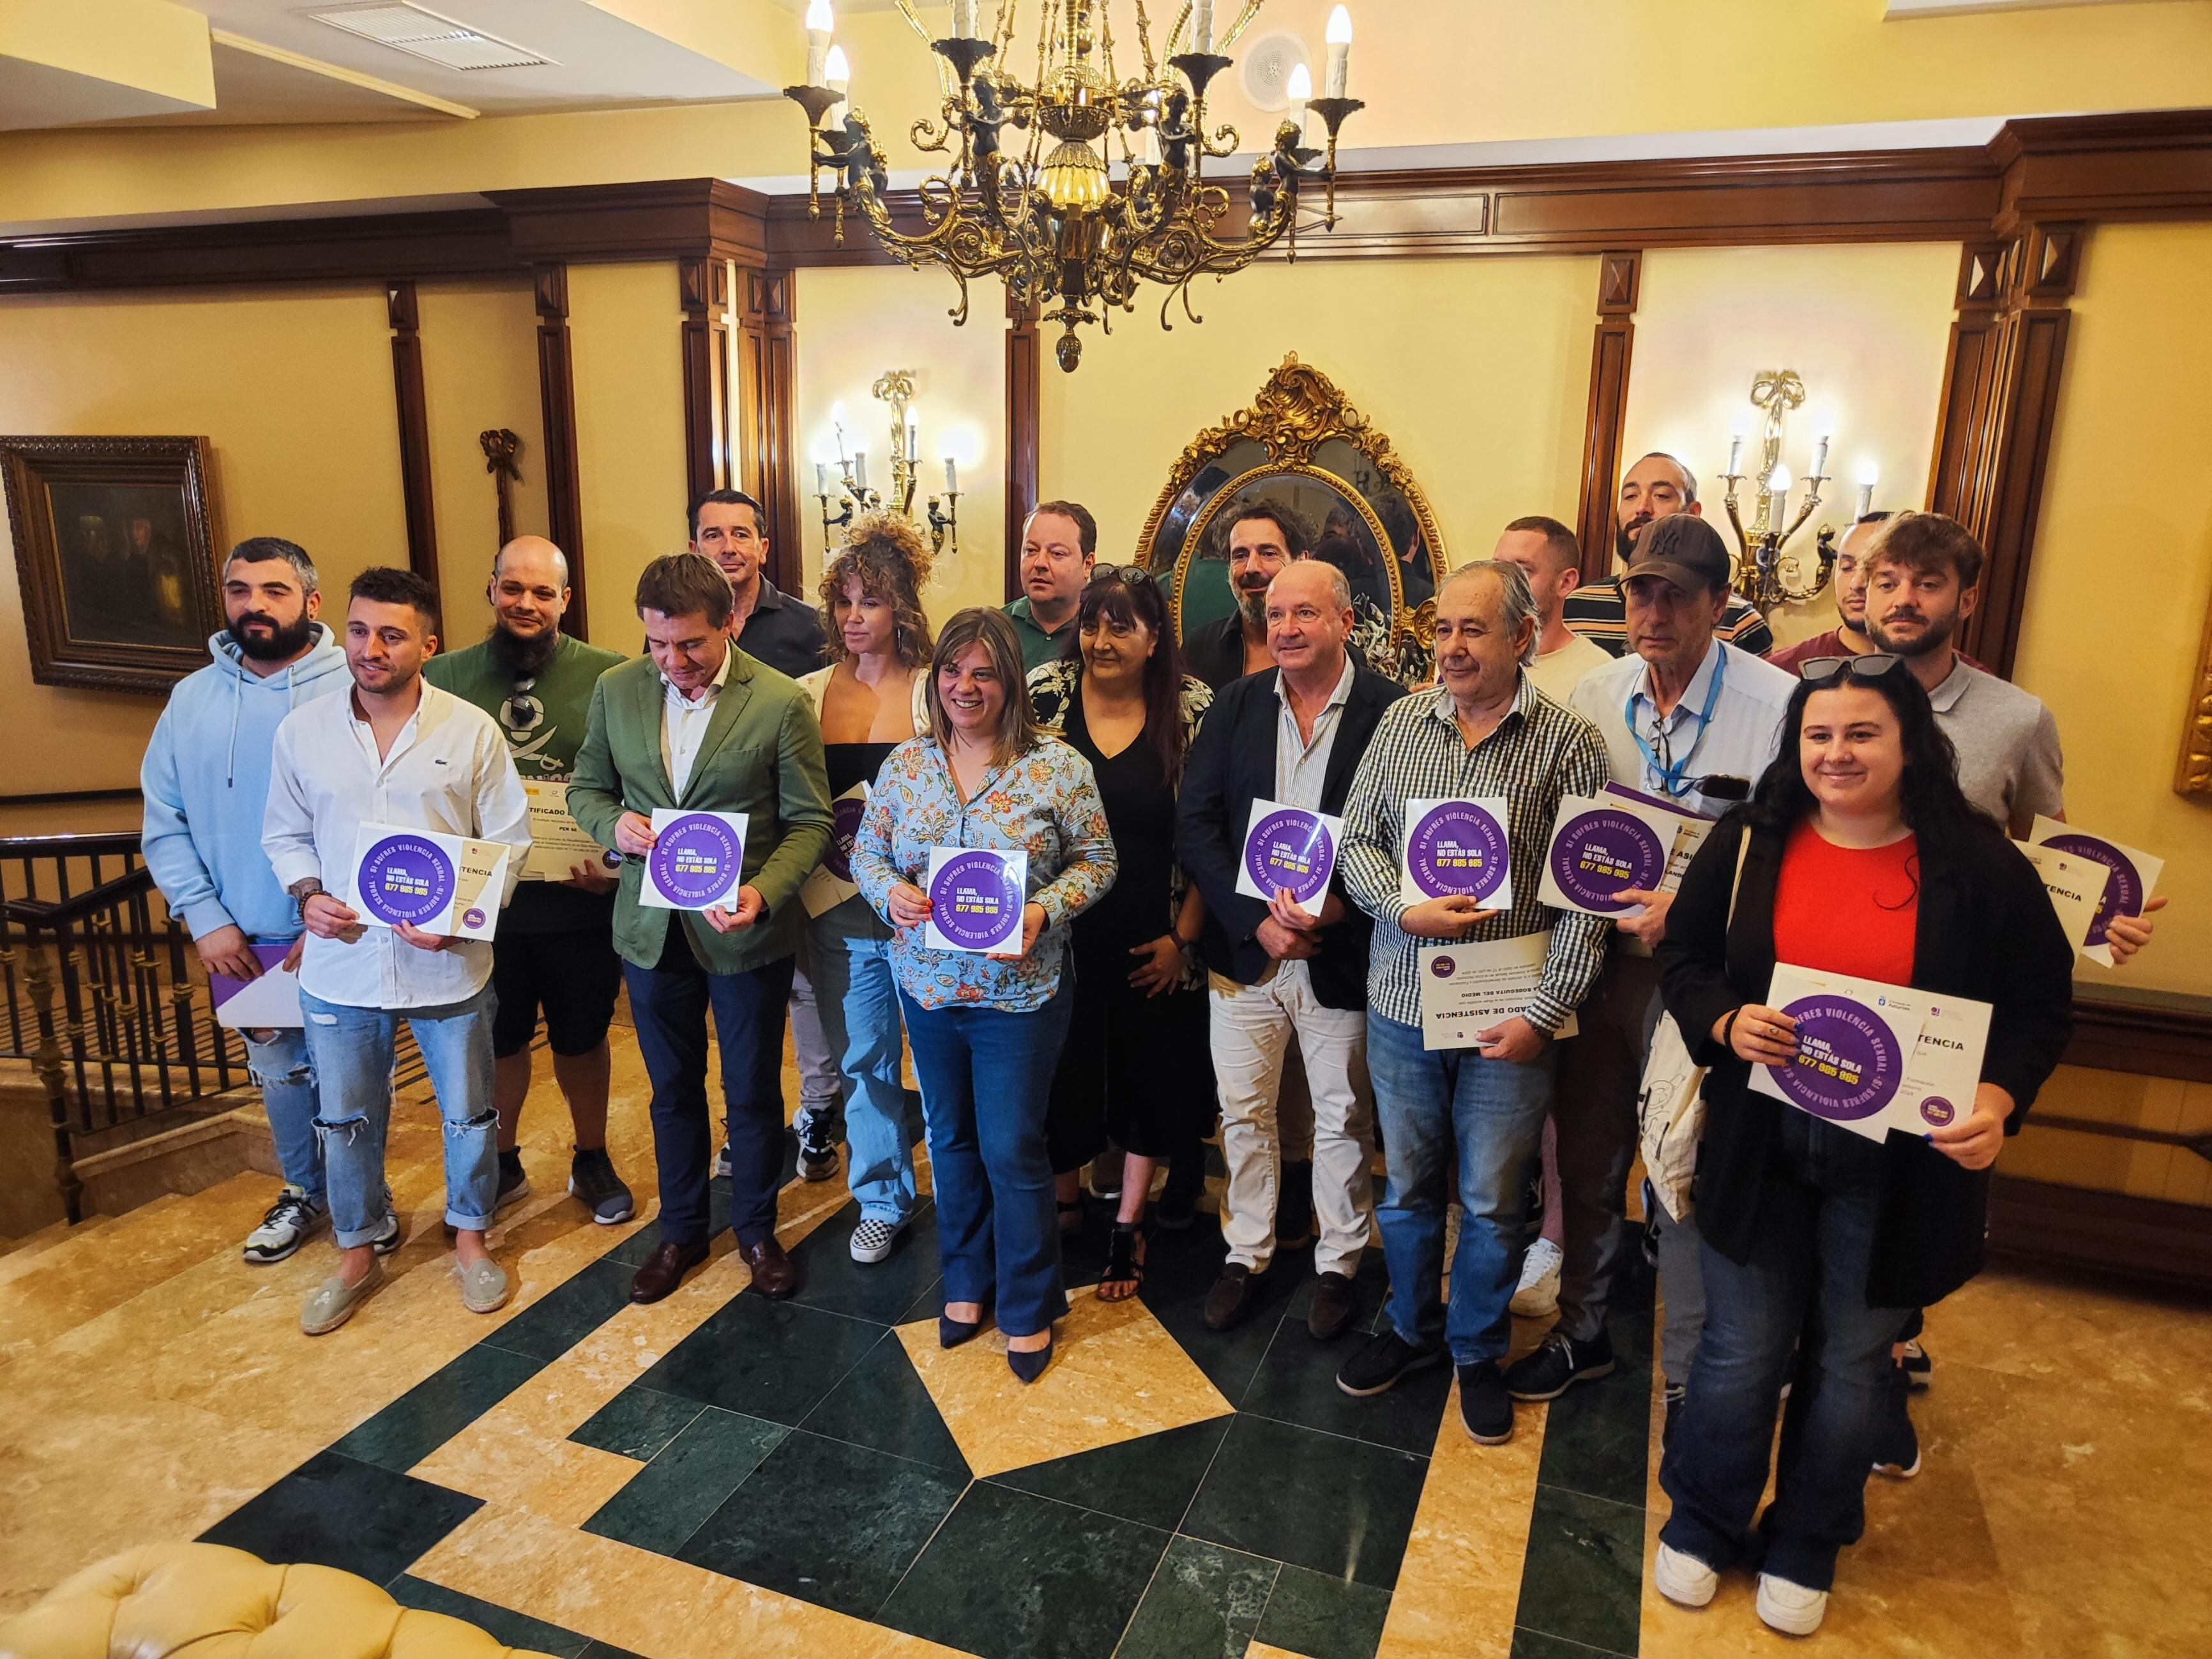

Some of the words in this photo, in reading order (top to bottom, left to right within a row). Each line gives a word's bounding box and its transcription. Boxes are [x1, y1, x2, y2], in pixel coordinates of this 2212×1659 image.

[1423, 817, 1444, 840] SUFRES
[1445, 812, 1480, 826] VIOLENCIA
[1480, 824, 1497, 851] SEXUAL
[665, 828, 687, 847] SUFRES
[688, 824, 721, 837] VIOLENCIA
[720, 835, 732, 859] SEXUAL
[1262, 821, 1284, 838] SUFRES
[1316, 837, 1324, 861] SEXUAL
[1566, 840, 1574, 848] SI
[1572, 821, 1599, 840] SUFRES
[1602, 820, 1641, 840] VIOLENCIA
[1639, 840, 1651, 866] SEXUAL
[678, 848, 697, 856] LLAMA,
[1273, 842, 1292, 852] LLAMA,
[1585, 844, 1608, 856] LLAMA,
[374, 846, 396, 865] SUFRES
[398, 844, 433, 860] VIOLENCIA
[432, 858, 445, 882] SEXUAL
[686, 855, 702, 863] ESTÁS
[1270, 858, 1282, 866] 677
[1280, 851, 1297, 861] ESTÁS
[1298, 856, 1310, 865] SOLA
[1437, 859, 1450, 867] 677
[1593, 854, 1614, 865] ESTÁS
[1615, 860, 1632, 870] SOLA
[1580, 861, 1596, 870] 677
[387, 867, 407, 876] LLAMA,
[944, 865, 965, 886] SUFRES
[967, 861, 1001, 875] VIOLENCIA
[396, 876, 414, 884] ESTÁS
[385, 883, 398, 891] 677
[957, 887, 977, 896] LLAMA,
[966, 895, 983, 904] ESTÁS
[1436, 1009, 1490, 1019] ASISTENCIA
[1803, 1034, 1832, 1053] LLAMA,
[1826, 1008, 1875, 1037] VIOLENCIA
[1870, 1038, 1887, 1072] SEXUAL
[1798, 1055, 1817, 1068] 677
[1801, 1045, 1812, 1055] NO
[1814, 1048, 1840, 1065] ESTÁS
[1840, 1059, 1862, 1073] SOLA
[1872, 1079, 1882, 1089] SI
